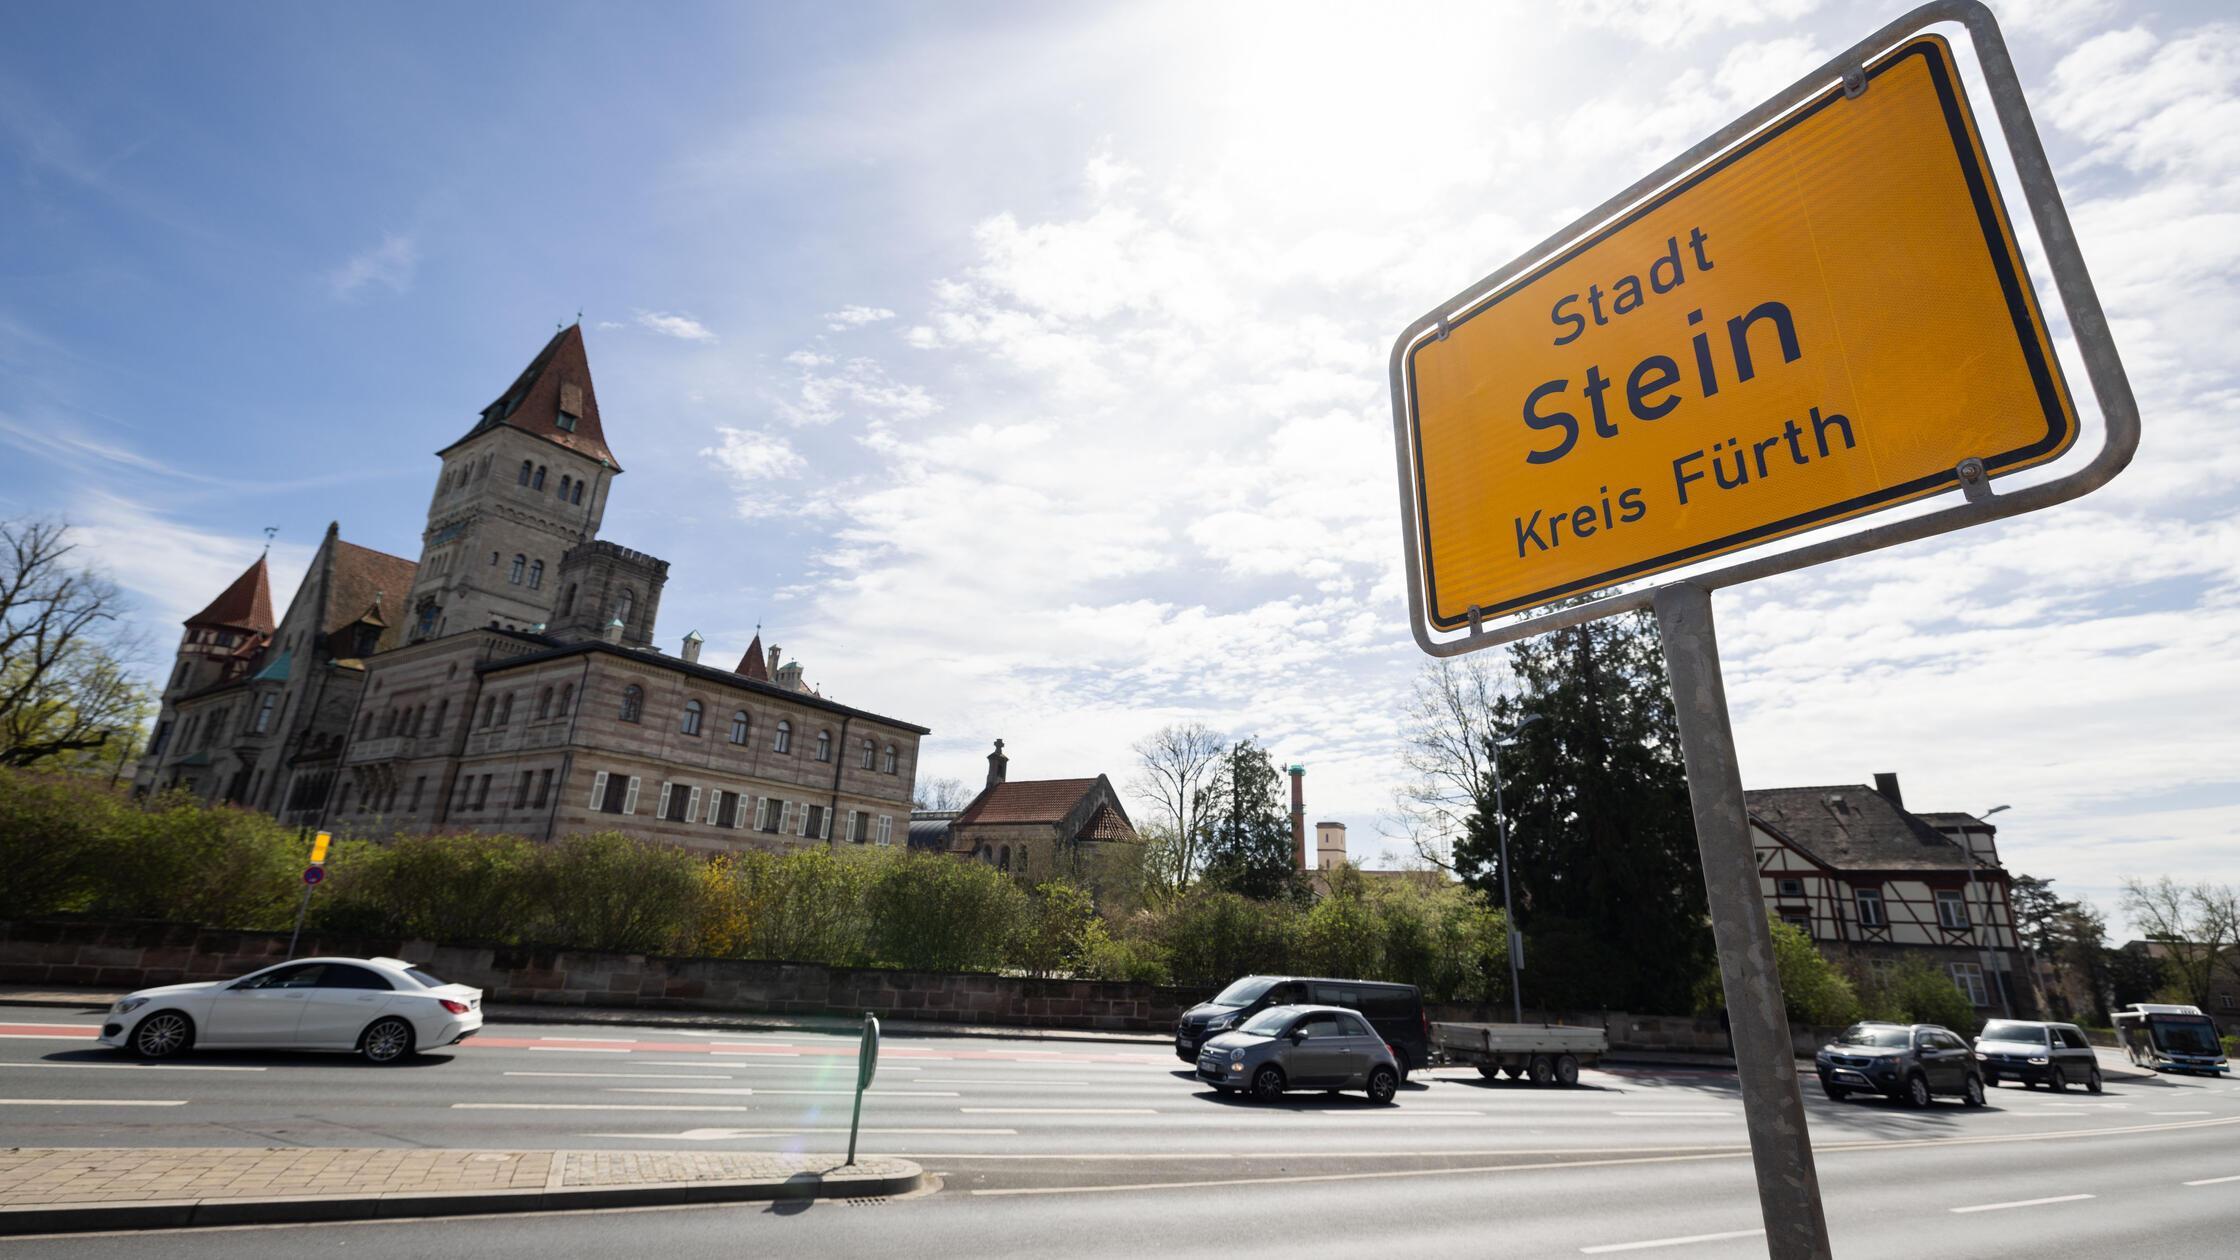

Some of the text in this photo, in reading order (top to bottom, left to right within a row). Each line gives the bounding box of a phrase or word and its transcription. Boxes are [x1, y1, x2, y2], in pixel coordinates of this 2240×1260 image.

[1551, 226, 1714, 347] Stadt
[1522, 301, 1802, 465] Stein
[1514, 406, 1857, 558] Kreis Fürth
